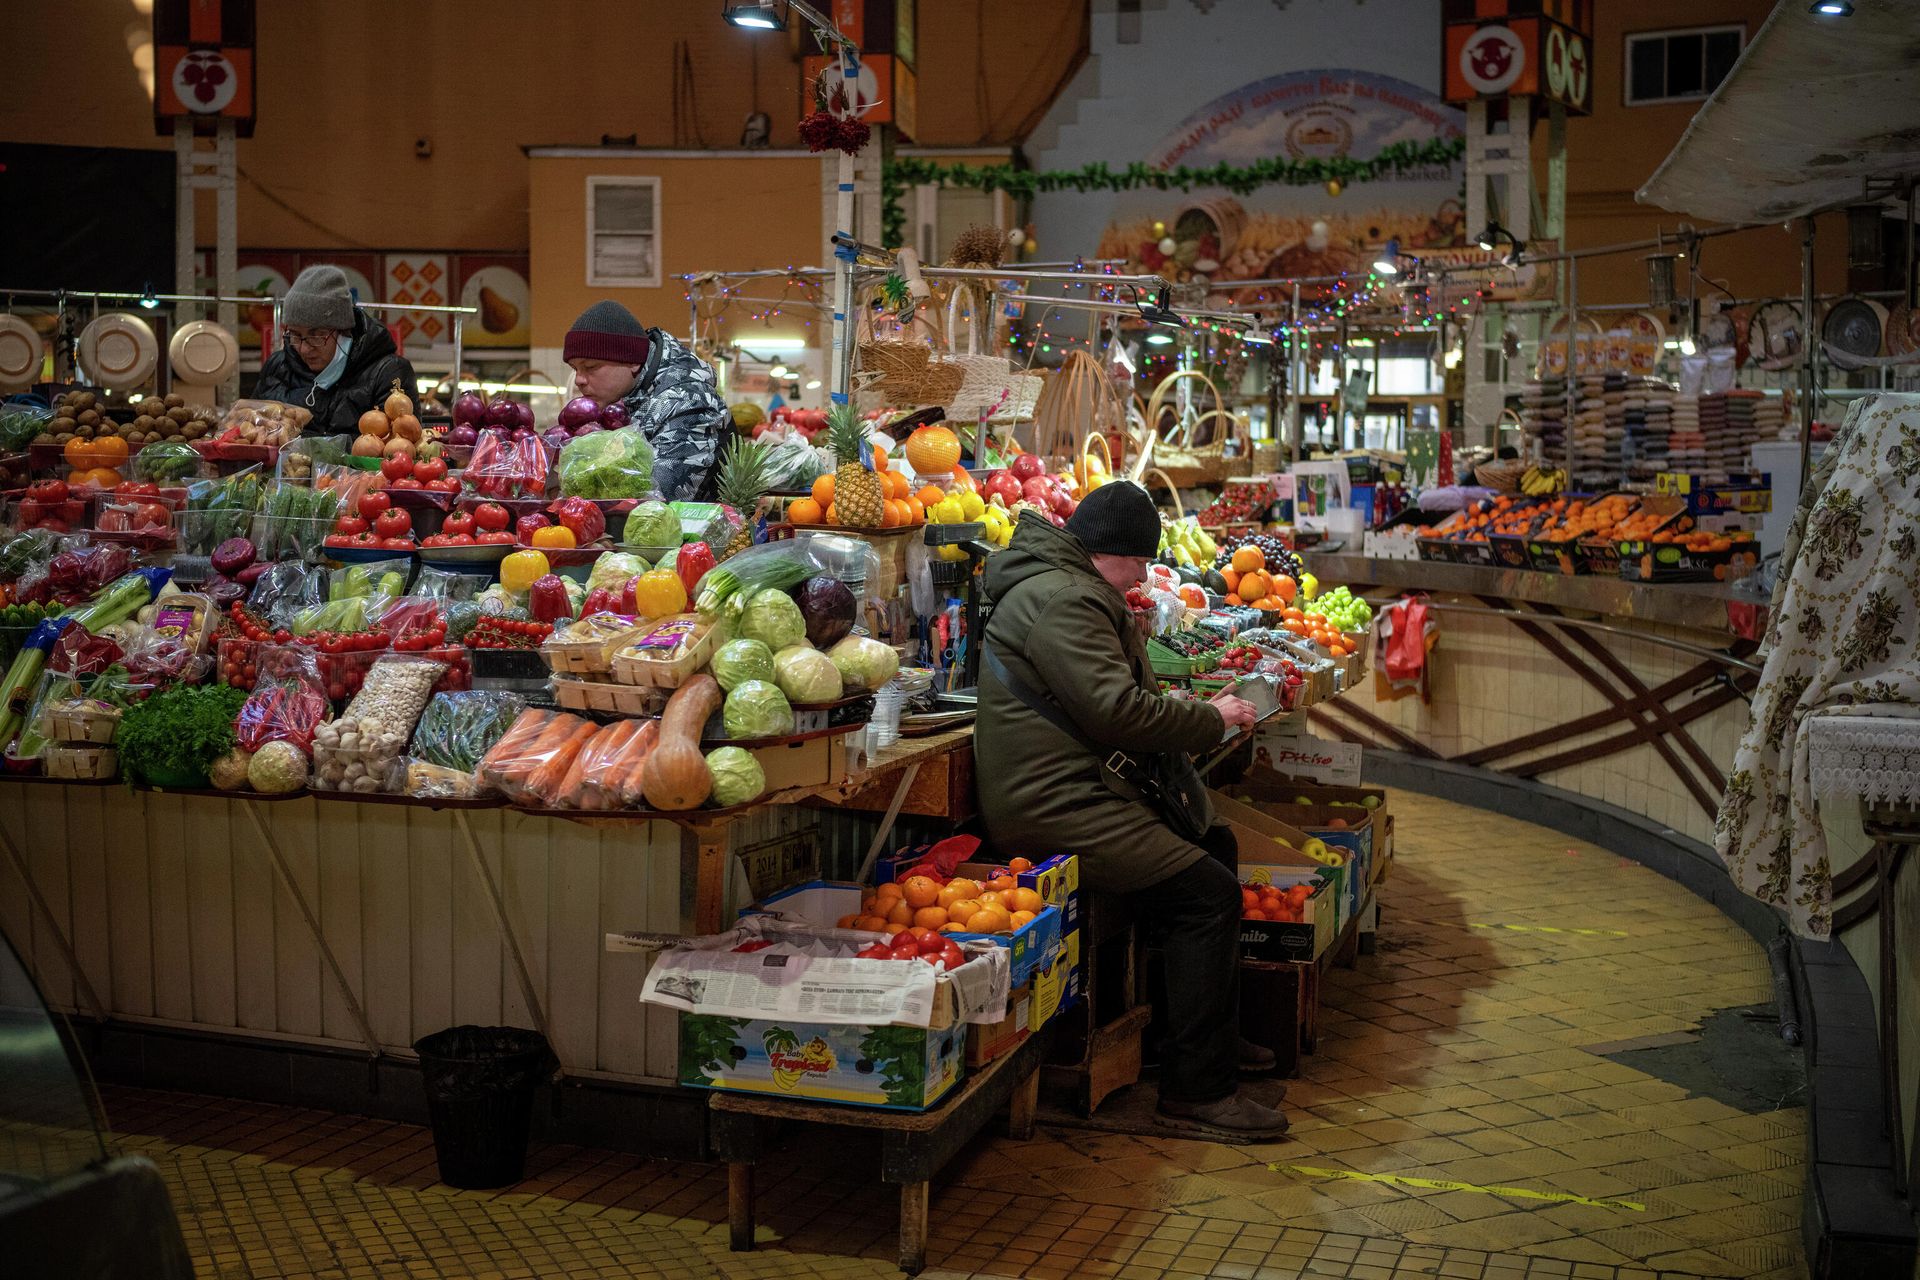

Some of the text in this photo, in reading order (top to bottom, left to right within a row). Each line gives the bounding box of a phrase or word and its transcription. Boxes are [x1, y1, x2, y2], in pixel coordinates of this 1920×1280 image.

[786, 1049, 805, 1059] Baby
[770, 1052, 832, 1074] Tropical
[806, 1071, 828, 1080] Republic
